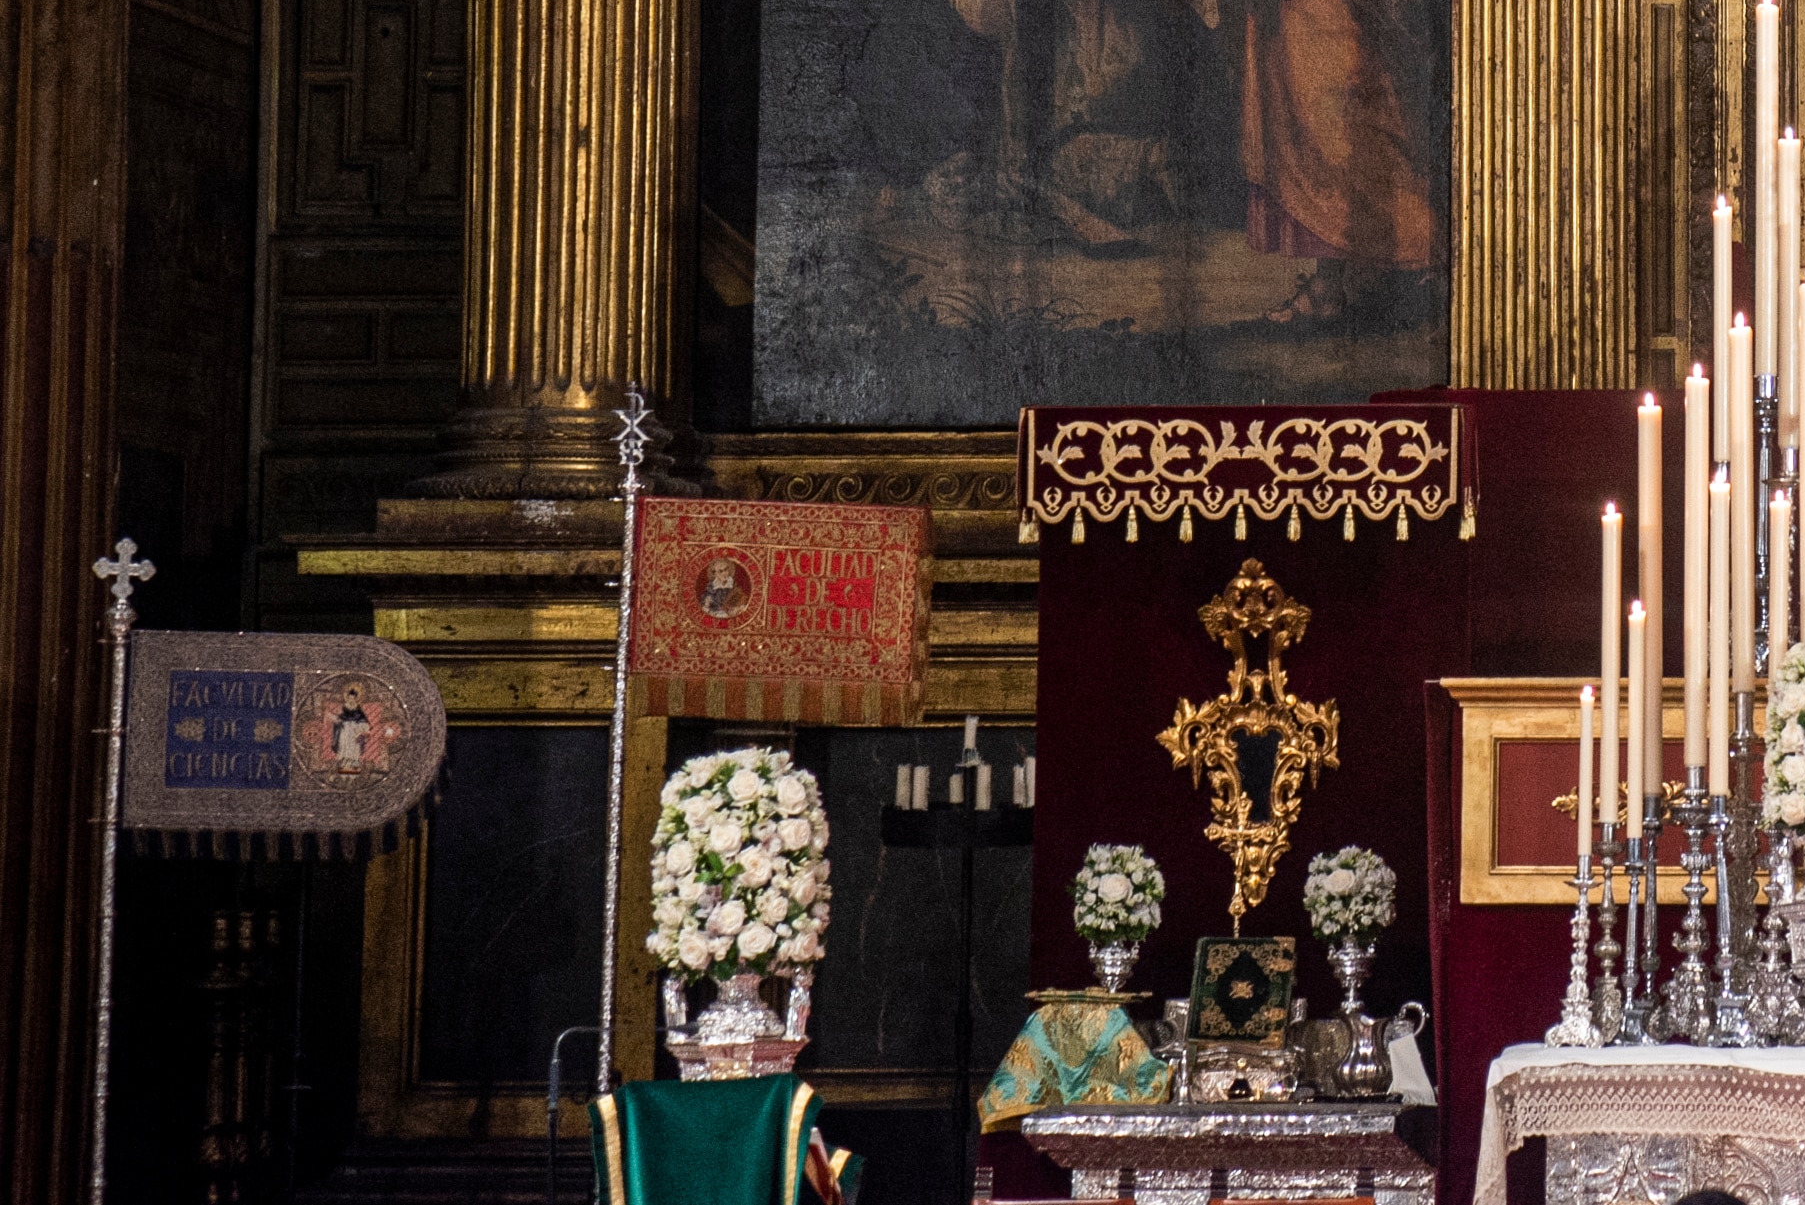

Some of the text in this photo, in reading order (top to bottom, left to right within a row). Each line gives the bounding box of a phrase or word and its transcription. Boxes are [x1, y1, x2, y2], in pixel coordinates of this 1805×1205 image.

[769, 549, 877, 578] FACULTAD
[804, 578, 837, 606] DE
[766, 605, 873, 636] DERECHO
[212, 717, 243, 742] DE
[169, 752, 287, 781] CIENCIAS
